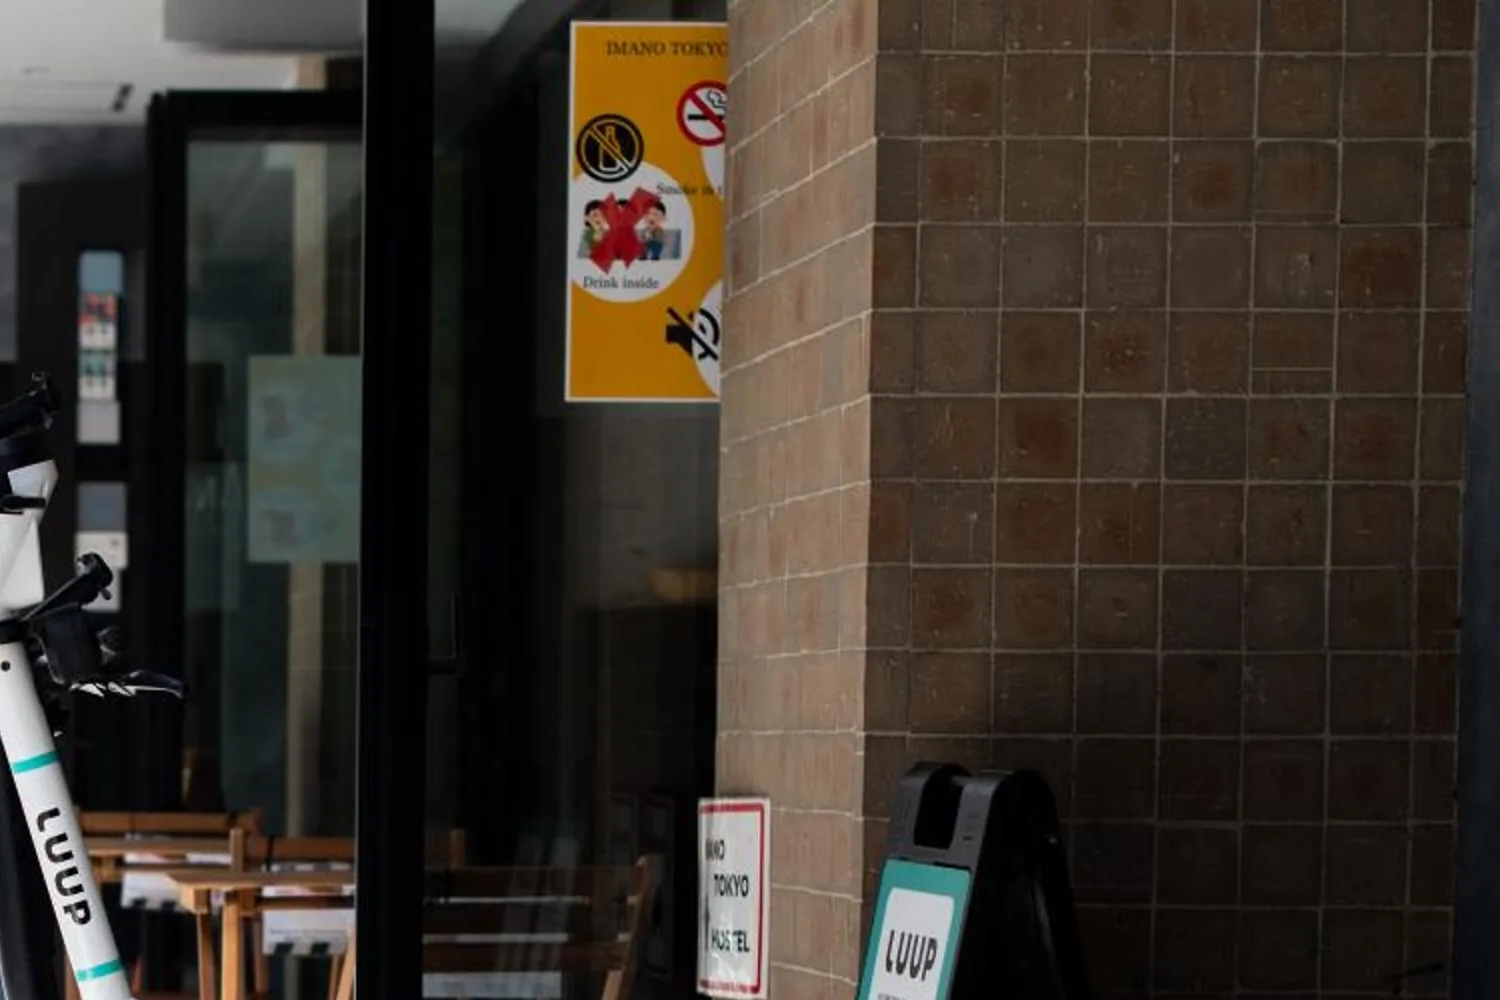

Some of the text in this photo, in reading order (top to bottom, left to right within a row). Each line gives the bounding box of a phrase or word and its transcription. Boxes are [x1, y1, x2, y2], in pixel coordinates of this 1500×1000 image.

[605, 40, 666, 56] IMANO
[583, 275, 659, 289] Drink inside
[36, 807, 92, 925] LUUP
[713, 873, 750, 897] TOKYO
[885, 929, 938, 982] LUUP
